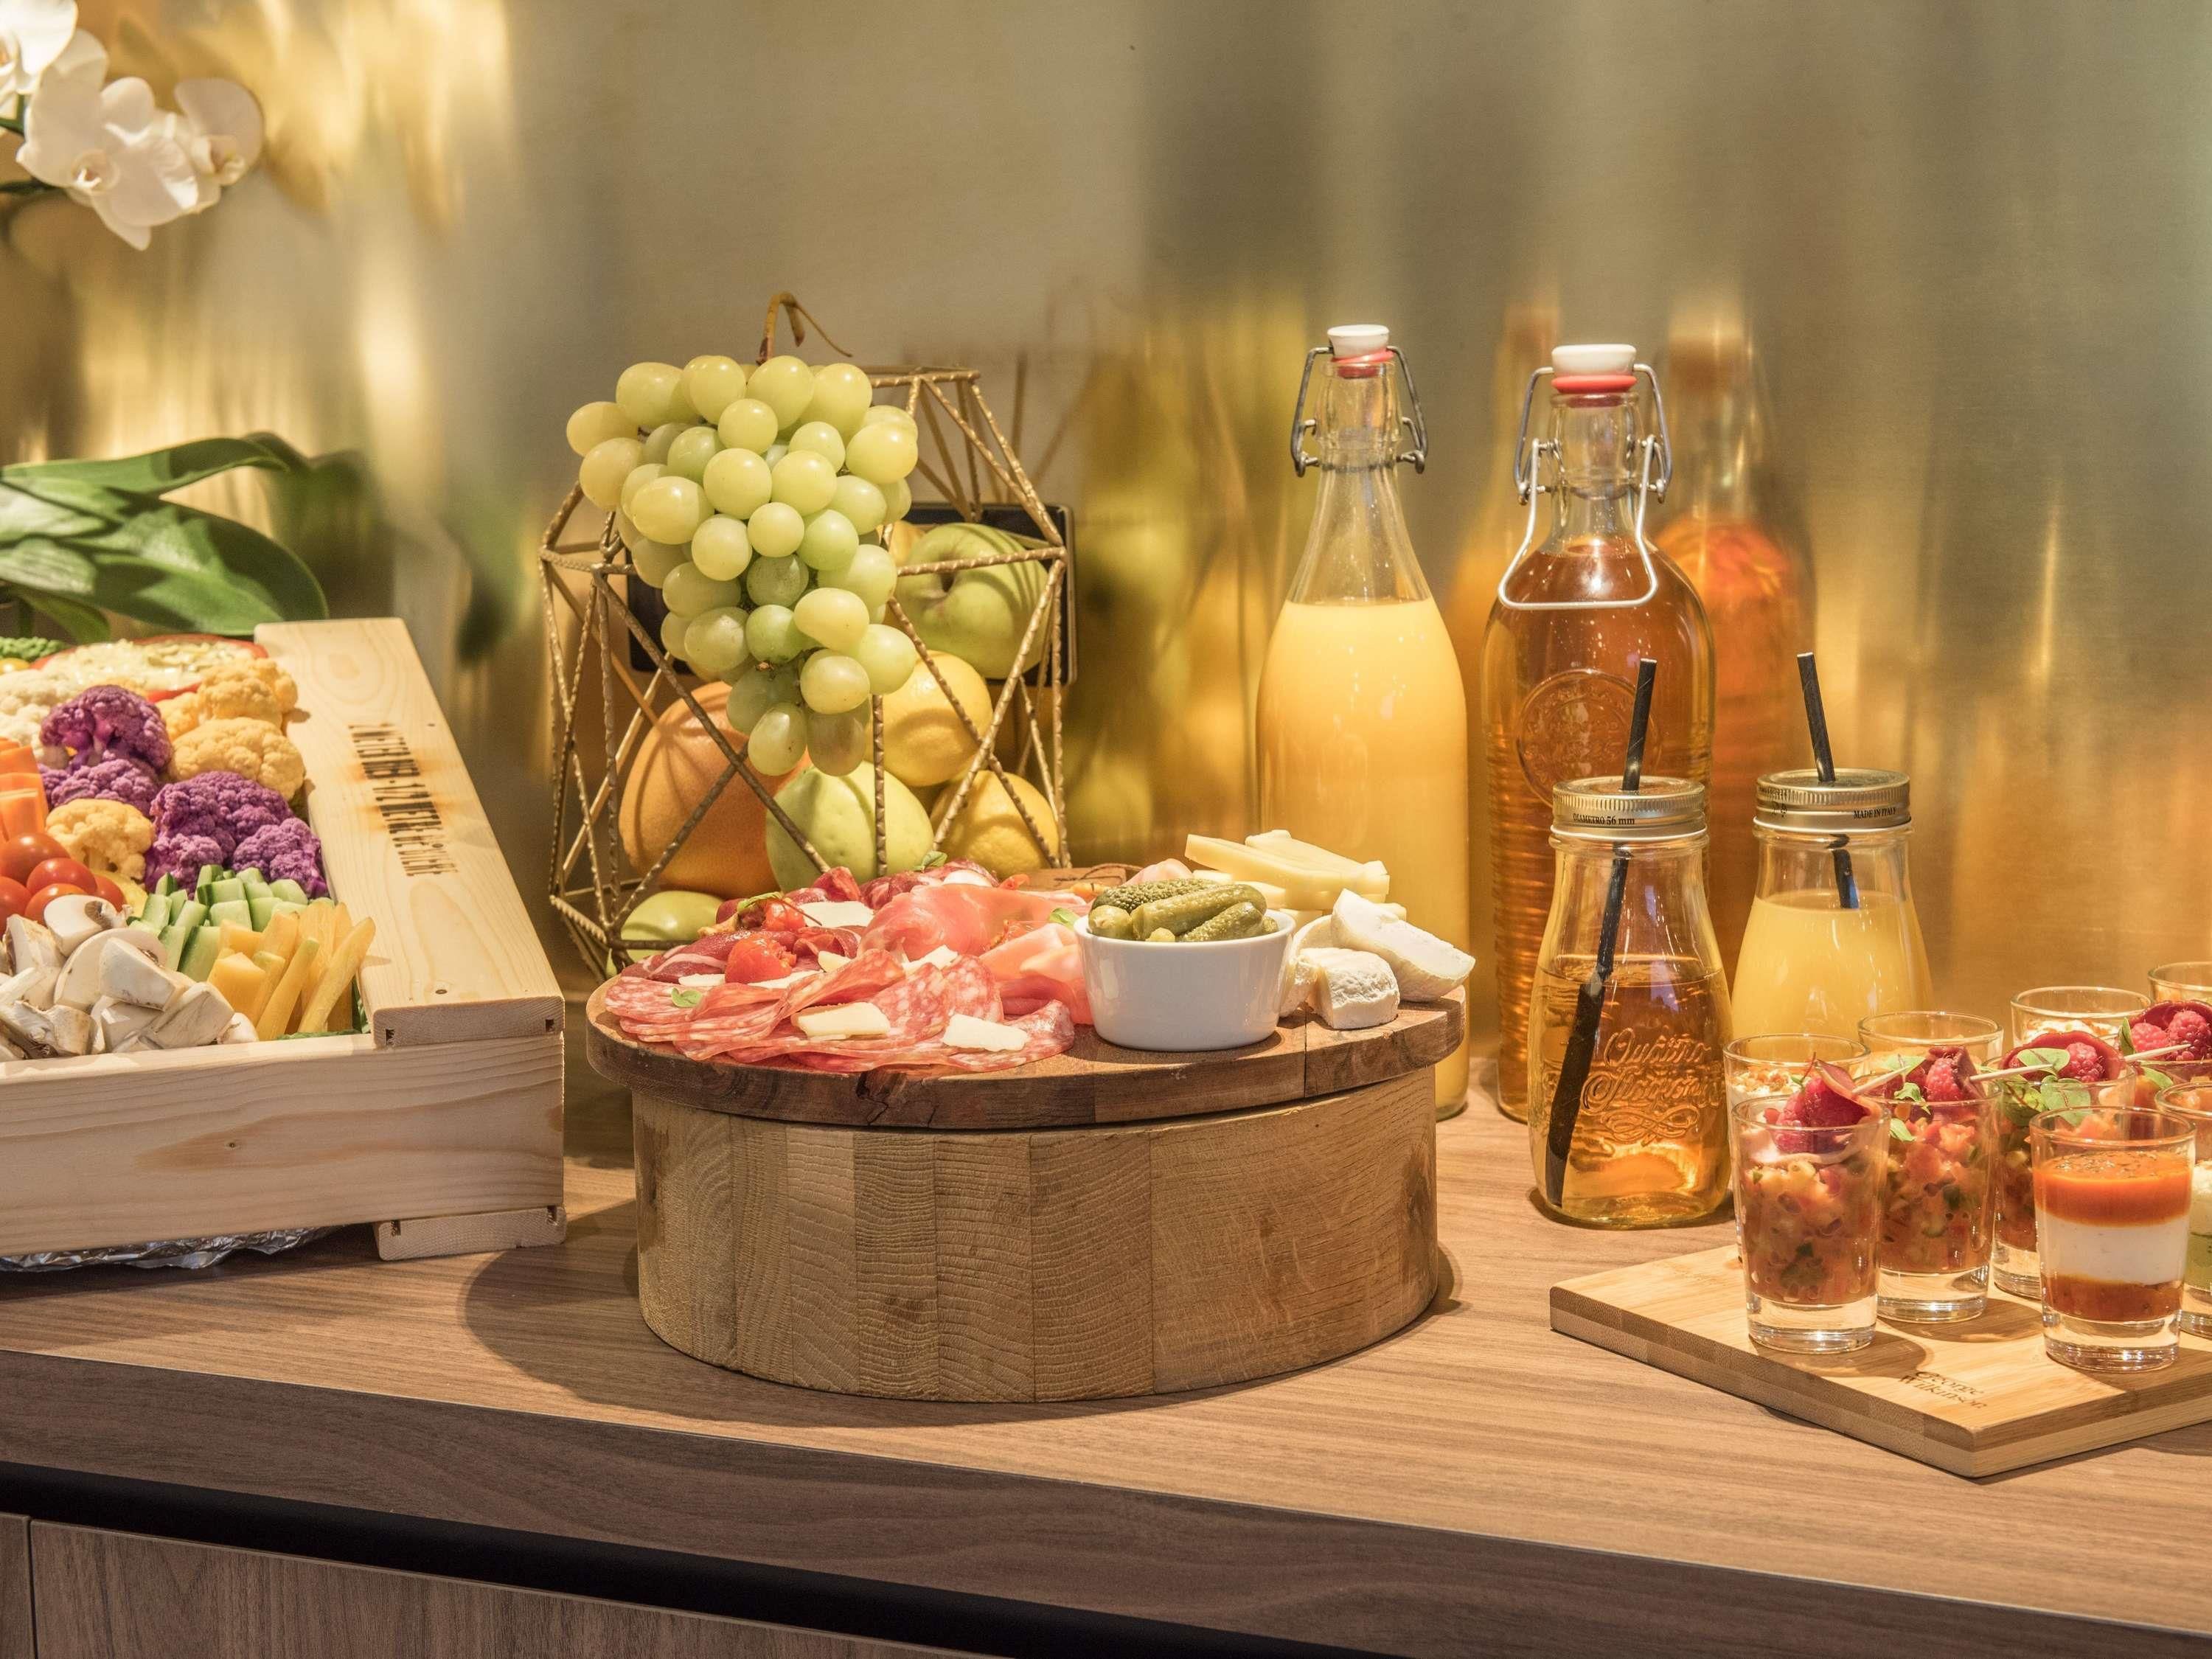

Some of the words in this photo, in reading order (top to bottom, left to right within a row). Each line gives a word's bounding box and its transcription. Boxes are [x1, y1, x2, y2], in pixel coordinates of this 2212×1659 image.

[1573, 813, 1605, 824] DIAMETRO
[1607, 815, 1617, 825] 56
[1854, 809, 1874, 819] MADE
[1874, 808, 1882, 818] IN
